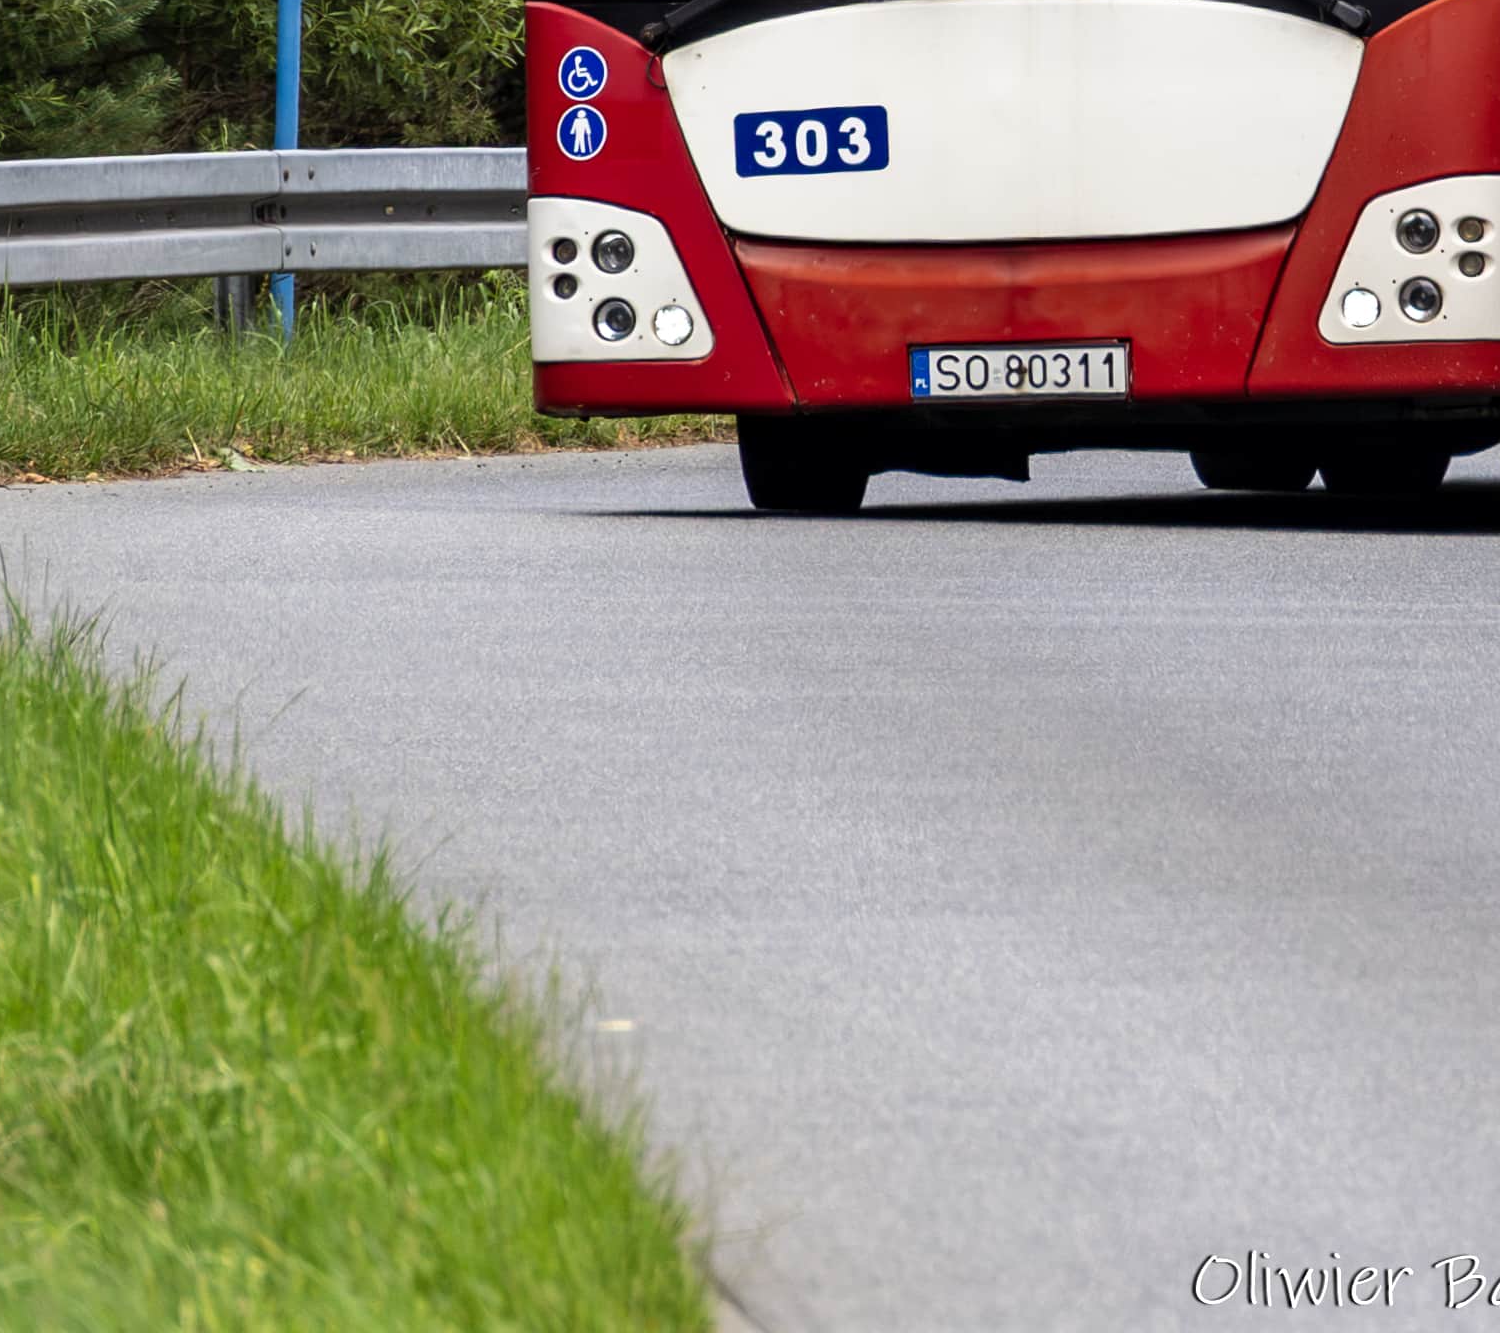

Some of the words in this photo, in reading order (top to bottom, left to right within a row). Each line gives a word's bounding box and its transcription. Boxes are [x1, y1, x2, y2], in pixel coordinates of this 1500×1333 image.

[753, 116, 872, 169] 303
[915, 378, 929, 389] PL
[936, 354, 989, 391] SO
[1004, 351, 1115, 389] 80311
